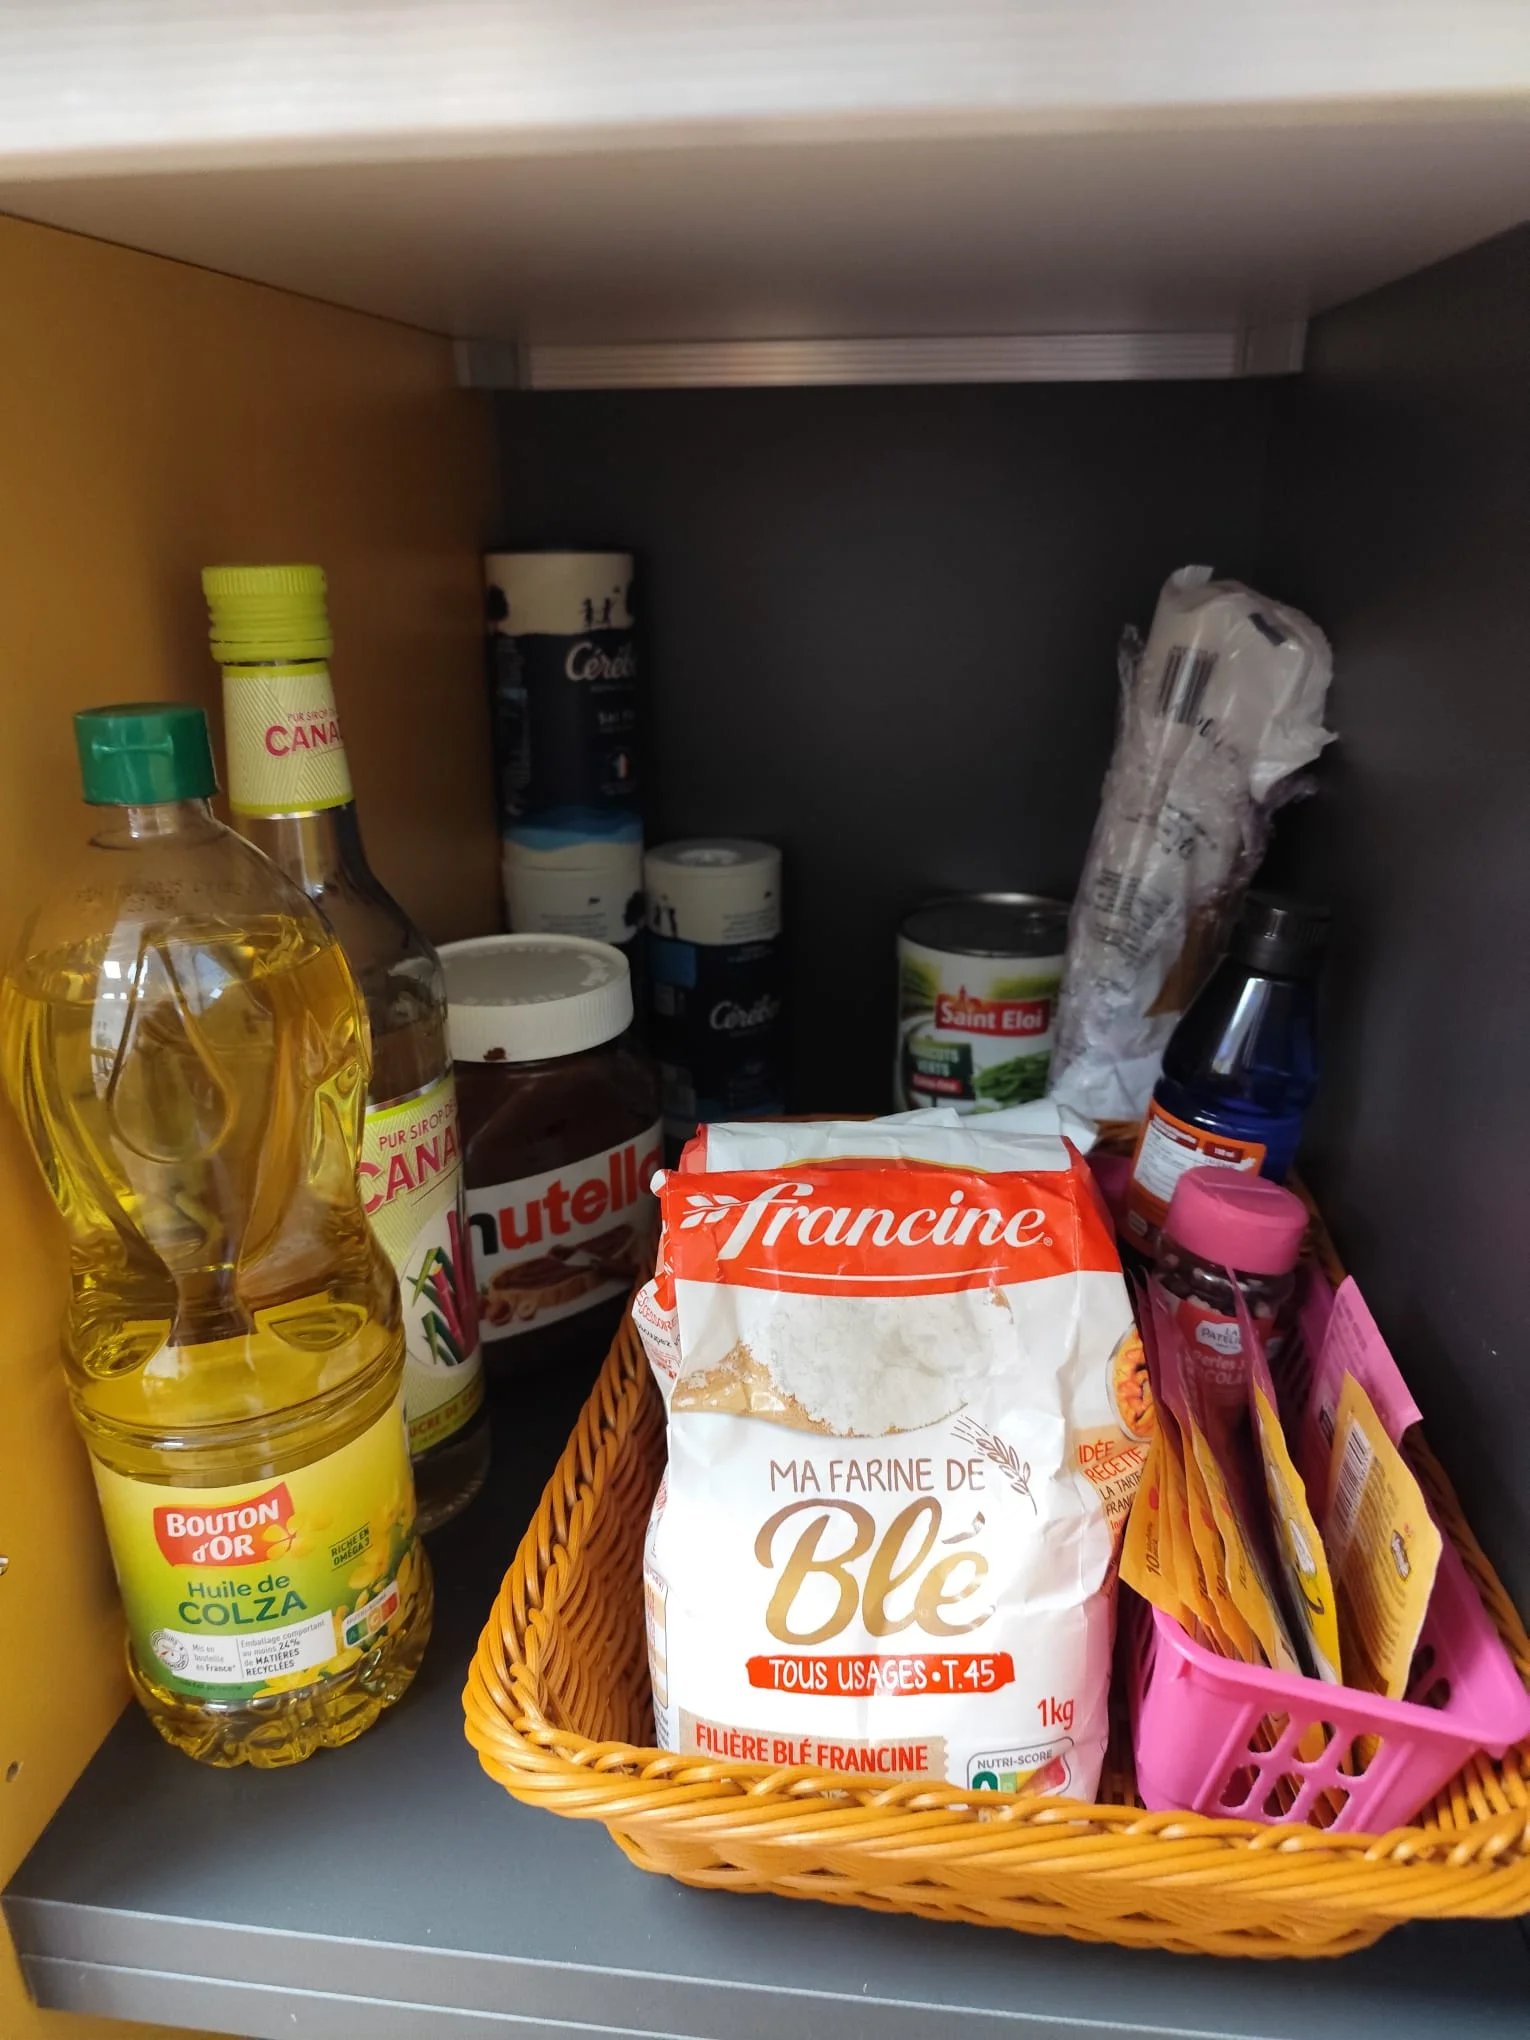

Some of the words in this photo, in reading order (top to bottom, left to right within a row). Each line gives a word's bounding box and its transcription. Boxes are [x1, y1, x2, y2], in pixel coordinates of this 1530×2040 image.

[941, 1001, 996, 1030] Saint
[1002, 1007, 1044, 1031] Eloi
[378, 1130, 407, 1152] PUR
[410, 1109, 444, 1140] SIROP
[357, 1125, 461, 1215] CANA
[717, 1182, 1046, 1261] francine
[409, 1413, 441, 1438] UCRE
[1078, 1440, 1115, 1465] IDÉE
[1084, 1447, 1148, 1484] RECETTE
[770, 1460, 821, 1493] MA
[829, 1458, 935, 1493] FARINE
[946, 1458, 986, 1492] DE
[1100, 1485, 1115, 1501] LA
[166, 1499, 279, 1538] BOUTON
[192, 1534, 256, 1564] d'OR
[331, 1534, 358, 1558] RICHE
[754, 1495, 997, 1646] Blé
[187, 1580, 253, 1600] Huile
[257, 1574, 291, 1594] de
[178, 1590, 308, 1627] COLZA
[241, 1634, 281, 1648] Emballage
[282, 1619, 326, 1640] comportant
[253, 1645, 277, 1656] moins
[278, 1638, 301, 1651] 24%
[245, 1658, 296, 1677] RECYCLÉES
[768, 1658, 828, 1690] TOUS
[838, 1658, 928, 1691] USAGES
[1037, 1696, 1075, 1732] 1kg
[695, 1721, 769, 1762] FILIÈRE
[772, 1737, 812, 1766] BLÉ
[817, 1744, 929, 1773] FRANCINE
[976, 1748, 1054, 1770] NUTRI-SCORE
